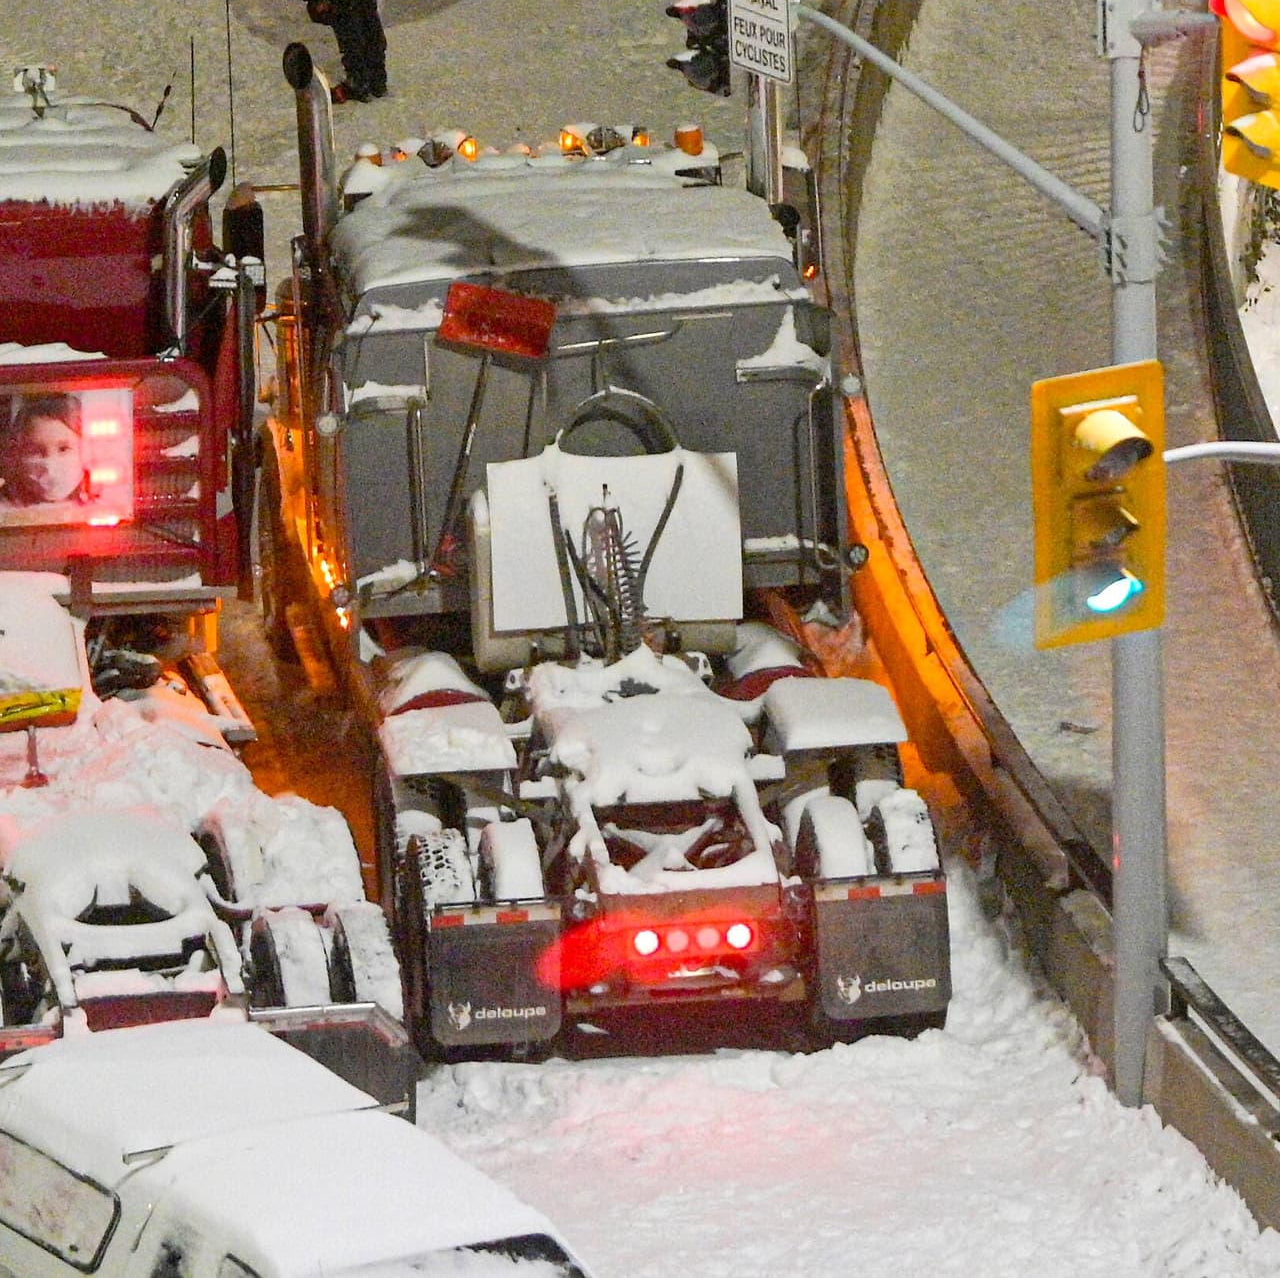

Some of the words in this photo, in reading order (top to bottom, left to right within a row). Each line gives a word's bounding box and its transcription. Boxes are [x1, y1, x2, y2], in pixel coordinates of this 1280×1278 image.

[734, 16, 757, 40] FEUX
[760, 25, 785, 50] POUR
[735, 40, 785, 73] CYCLISTES
[864, 978, 937, 993] deloupe
[475, 1006, 546, 1019] deloupe
